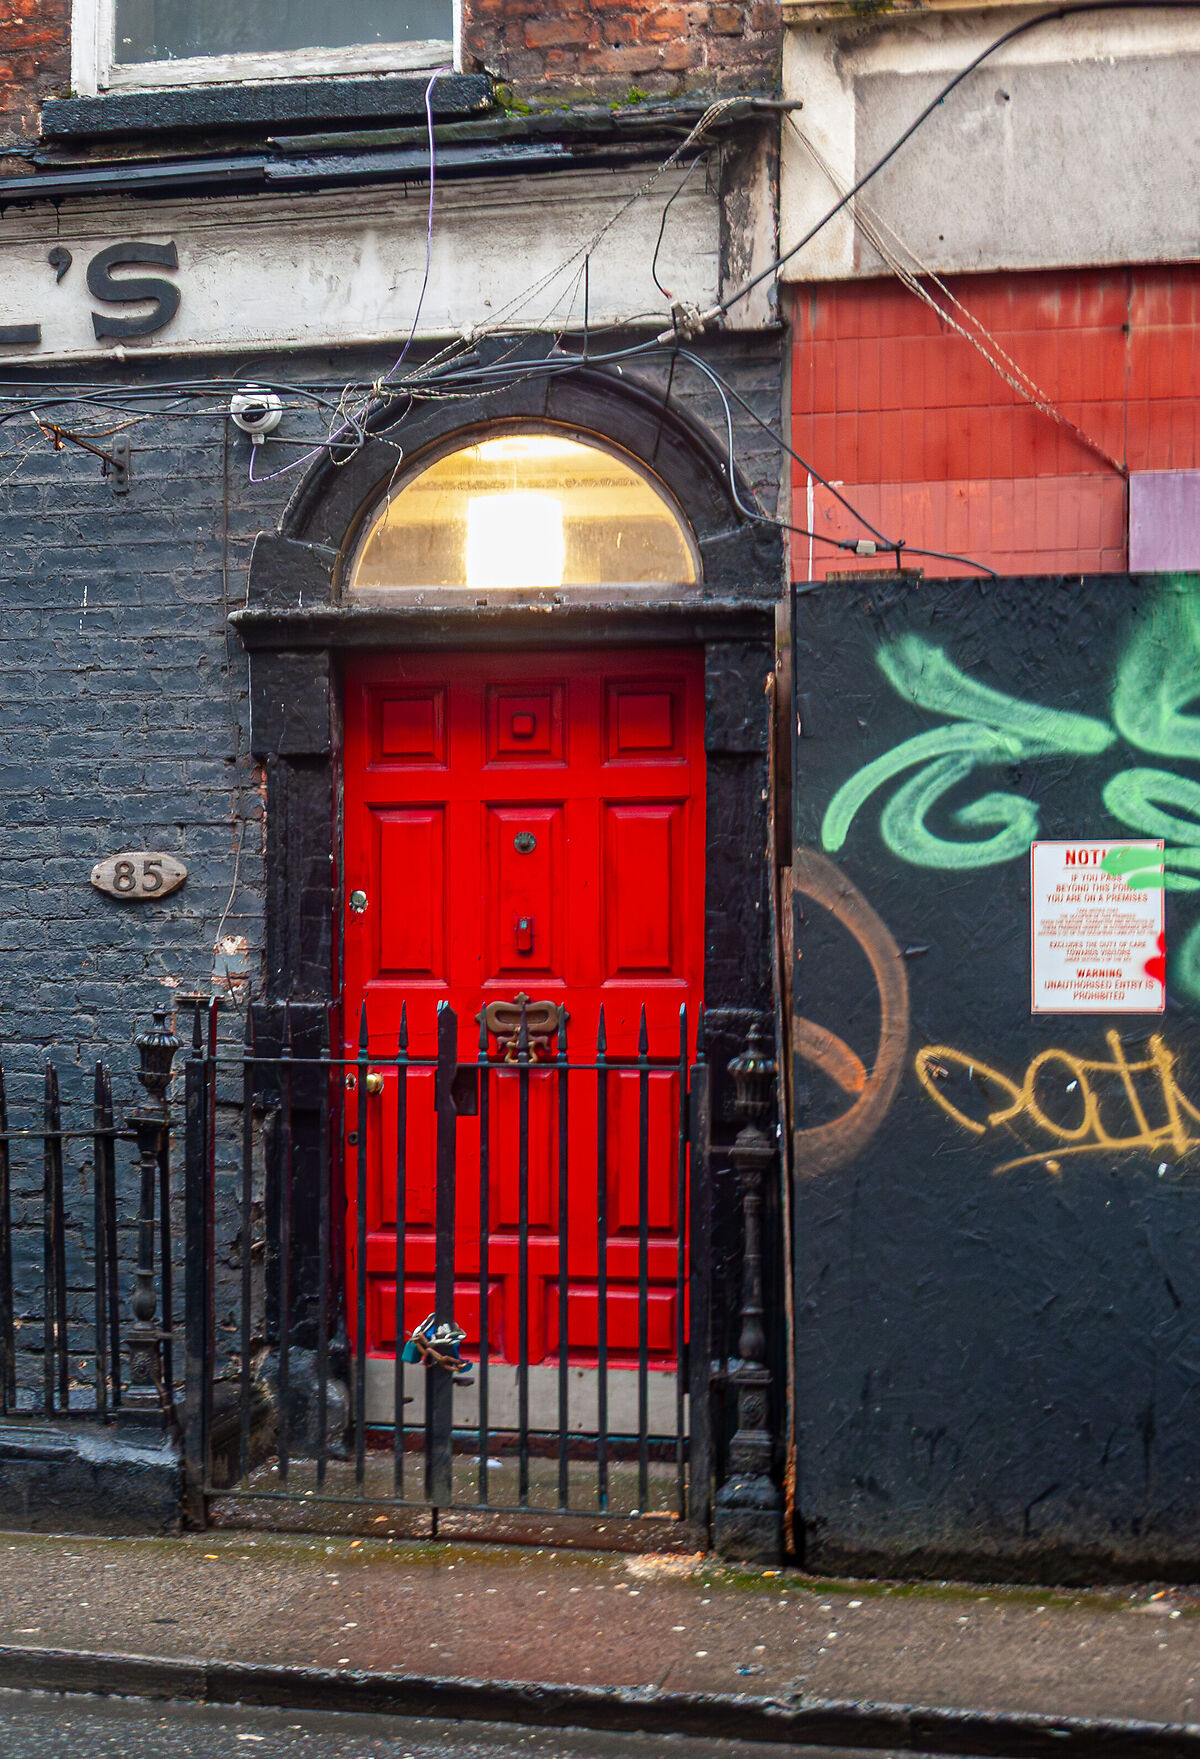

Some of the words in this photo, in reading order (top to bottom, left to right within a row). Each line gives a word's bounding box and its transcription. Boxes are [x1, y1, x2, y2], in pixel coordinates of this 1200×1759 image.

[113, 860, 164, 893] 85
[1082, 873, 1098, 882] YOU
[1056, 883, 1089, 892] BEYOND
[1092, 883, 1110, 892] THIS
[1047, 893, 1064, 903] YOU
[1066, 893, 1081, 902] ARE
[1084, 893, 1096, 902] ON
[1098, 893, 1104, 902] A
[1105, 893, 1148, 903] PREMISES
[1076, 968, 1122, 978] WARNING
[1044, 980, 1112, 990] UNAUTHORISED
[1114, 980, 1143, 990] ENTRY
[1146, 980, 1154, 990] IS
[1073, 991, 1125, 1000] PROHIBITED
